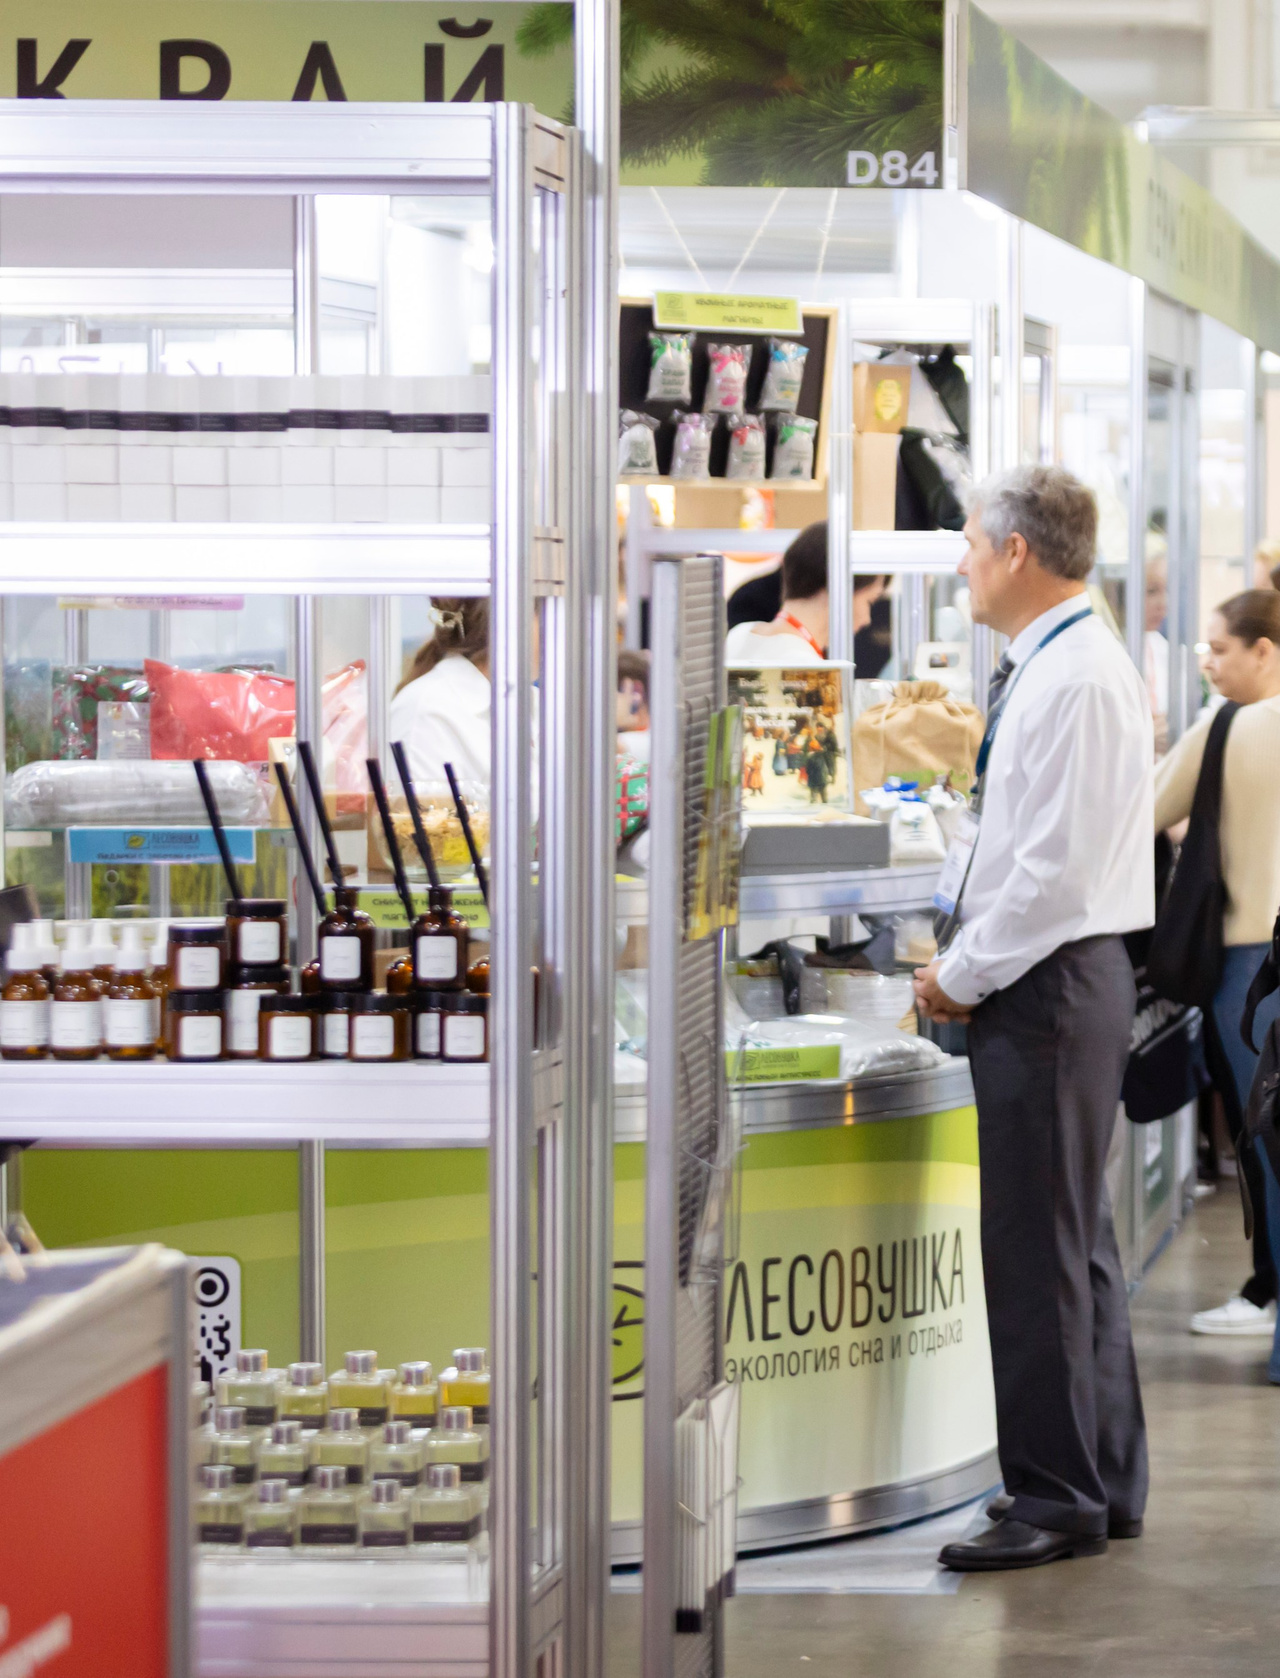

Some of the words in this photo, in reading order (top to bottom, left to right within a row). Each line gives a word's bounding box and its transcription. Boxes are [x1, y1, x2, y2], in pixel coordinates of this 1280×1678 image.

[16, 17, 505, 102] КРАЙ
[847, 149, 940, 186] D84
[724, 1228, 965, 1345] ЛЕСОВУШКА
[725, 1345, 840, 1384] экология
[849, 1337, 884, 1368] сна
[891, 1333, 902, 1360] и
[908, 1318, 963, 1358] отдыха
